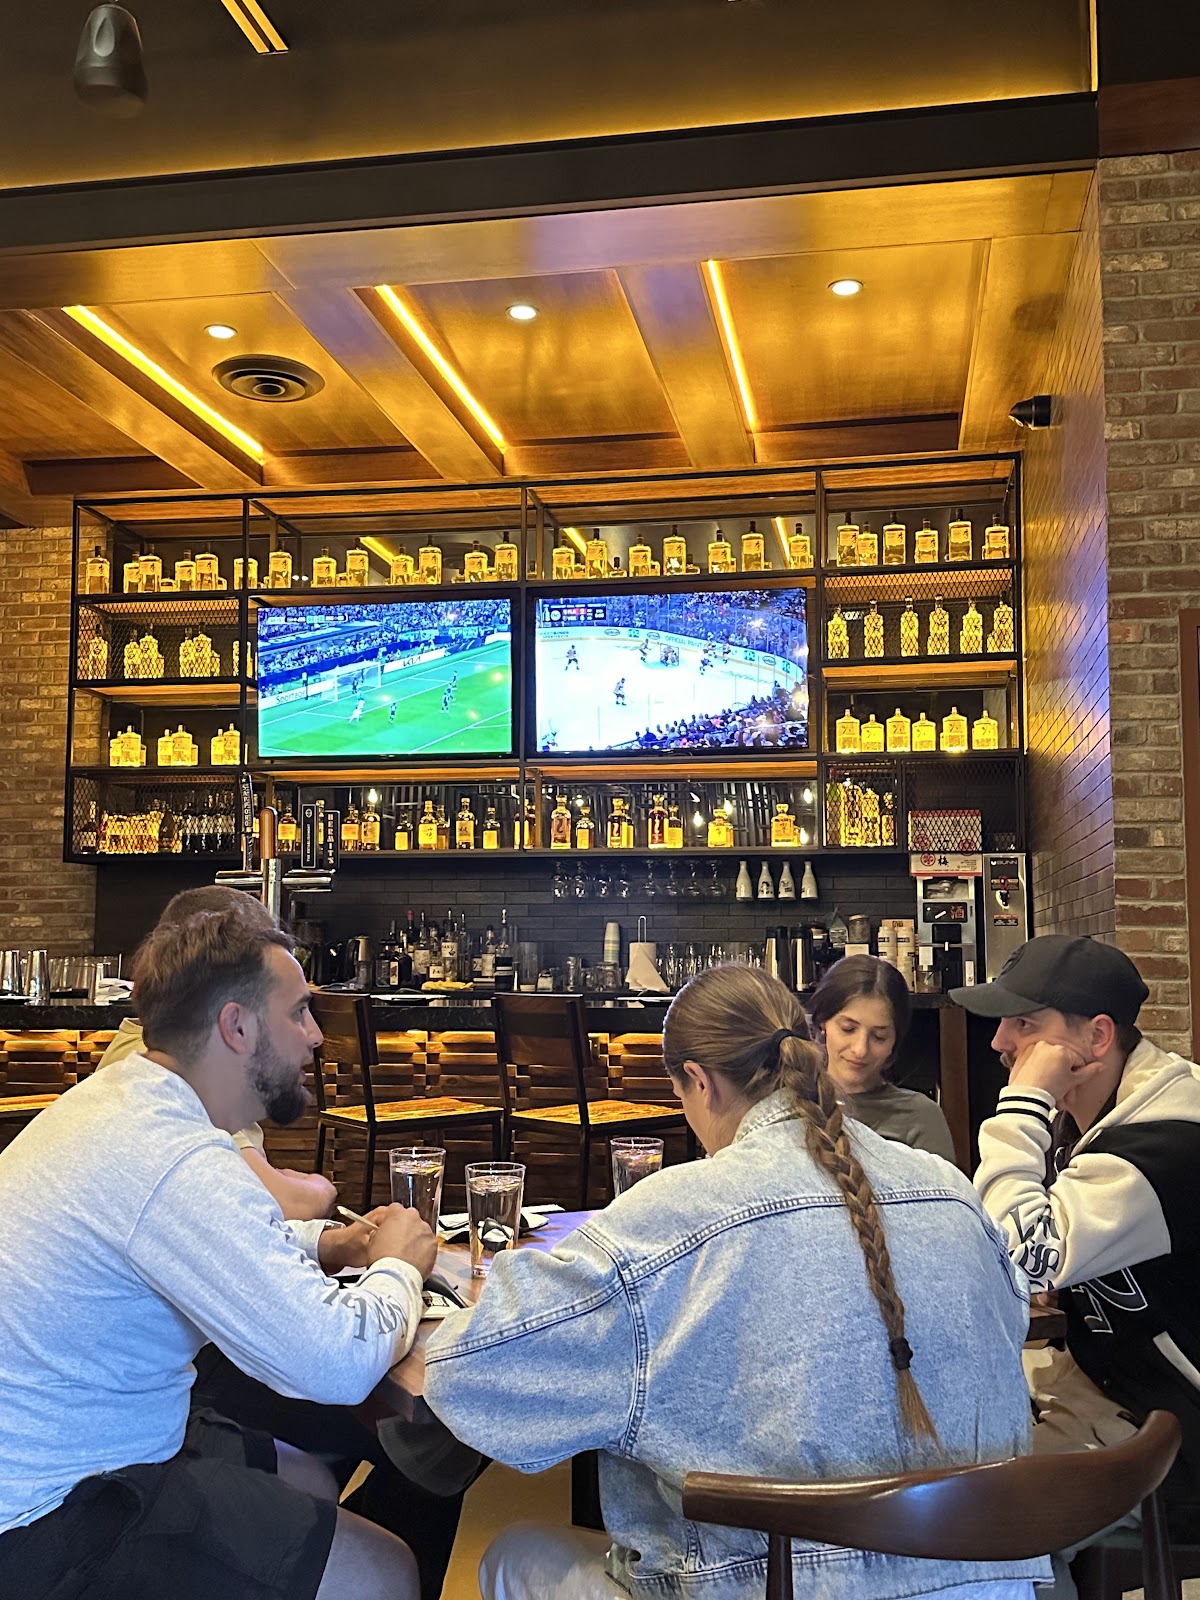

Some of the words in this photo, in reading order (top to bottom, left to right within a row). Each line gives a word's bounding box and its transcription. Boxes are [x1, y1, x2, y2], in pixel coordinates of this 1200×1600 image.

[664, 635, 687, 646] OFFICIAL
[687, 640, 703, 648] PAINT
[402, 655, 421, 667] KIA
[326, 813, 335, 864] HERMITS
[950, 905, 965, 920] 酒
